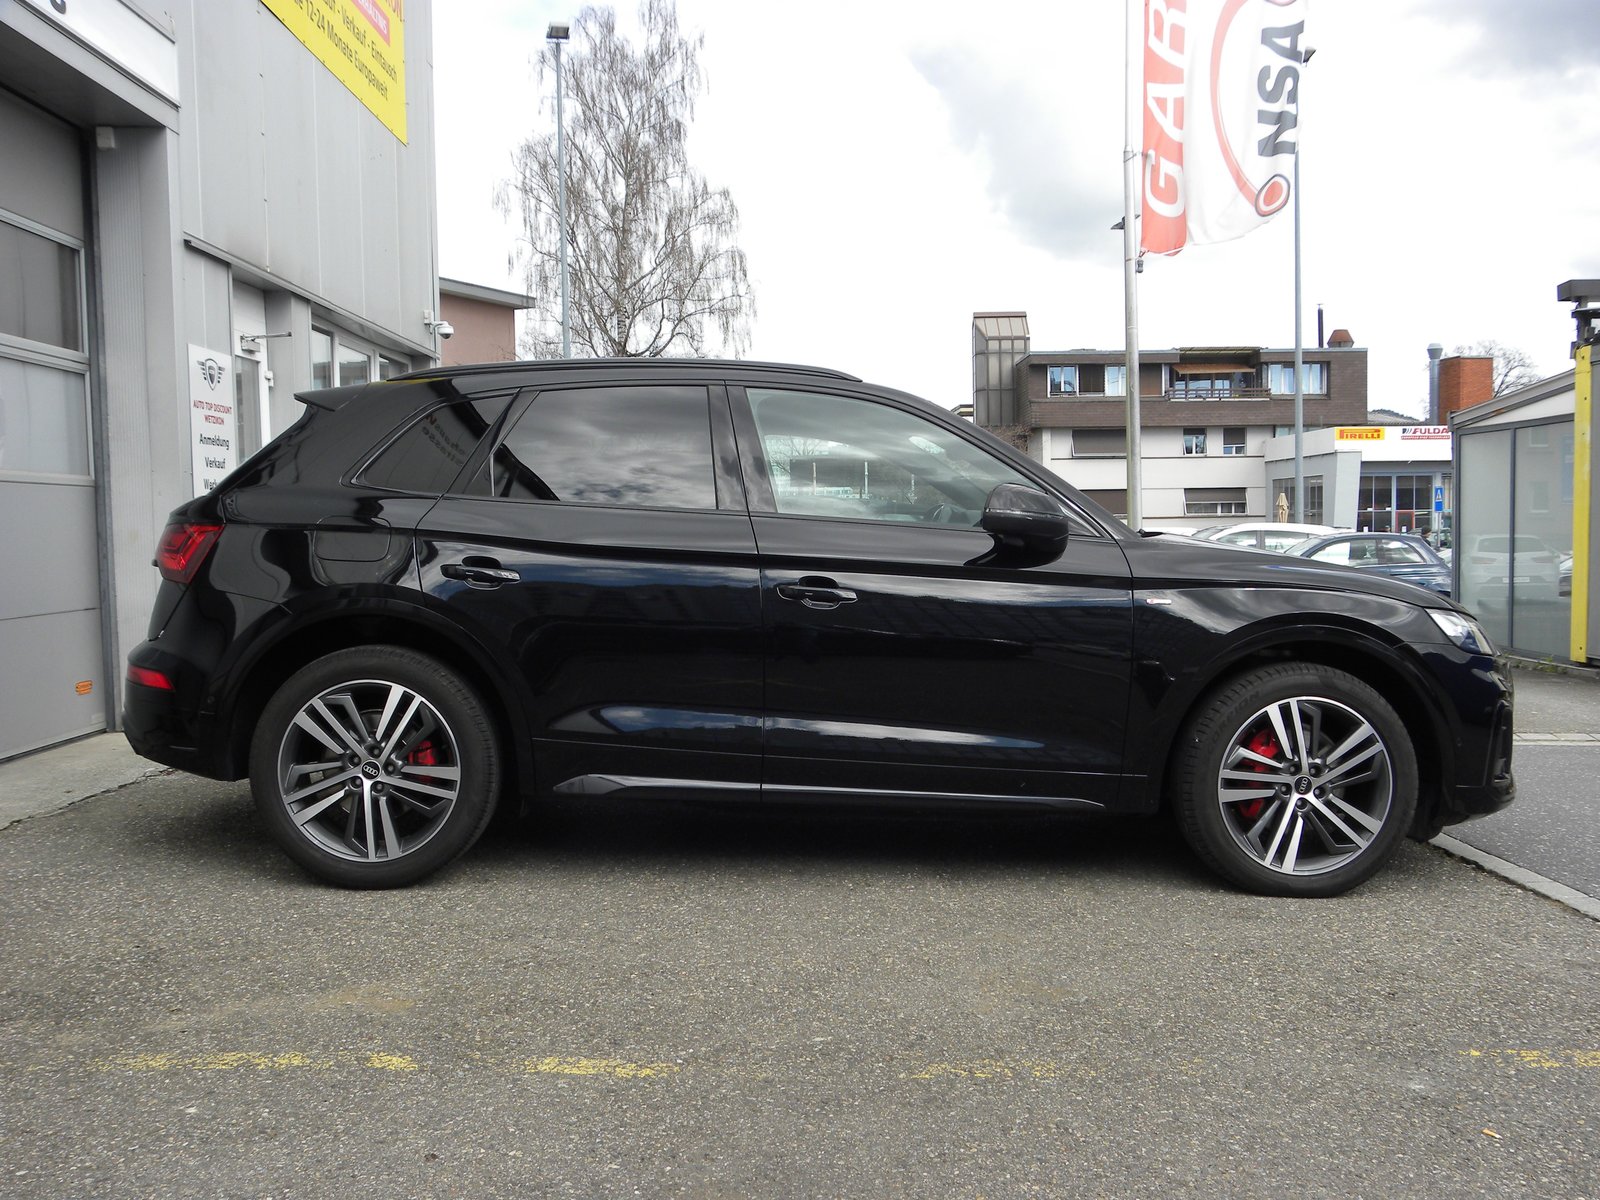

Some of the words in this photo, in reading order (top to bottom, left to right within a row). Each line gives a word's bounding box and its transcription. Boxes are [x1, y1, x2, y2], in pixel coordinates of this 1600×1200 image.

[306, 0, 326, 34] 12-24
[327, 20, 354, 63] Monate
[354, 50, 388, 101] Europaweit
[341, 5, 367, 48] Verkauf
[371, 40, 398, 85] Eintausch
[1257, 20, 1305, 158] NSA
[193, 400, 205, 410] AUTO
[205, 402, 213, 411] TOP
[213, 404, 232, 414] DISCOUNT
[199, 433, 230, 451] Anmeldung
[1340, 429, 1380, 440] PIRELLI
[204, 457, 226, 469] Verkauf
